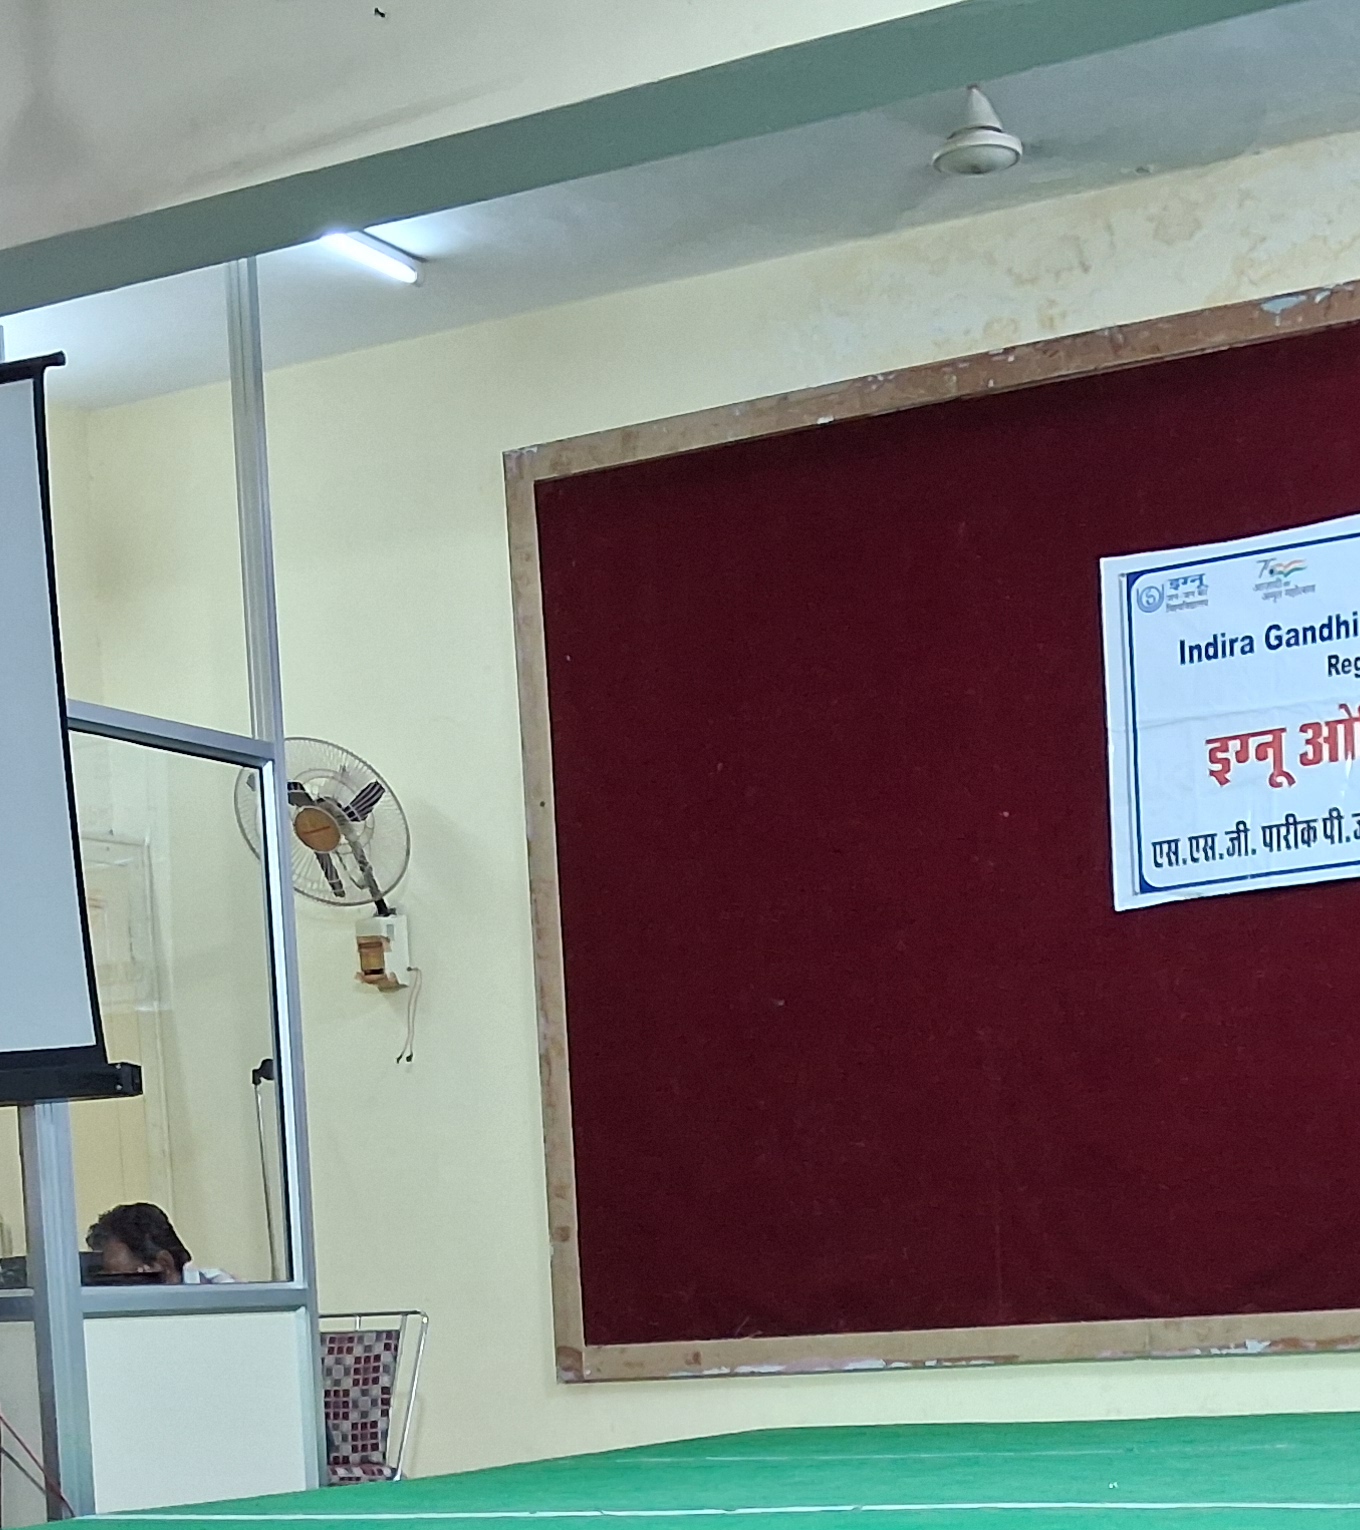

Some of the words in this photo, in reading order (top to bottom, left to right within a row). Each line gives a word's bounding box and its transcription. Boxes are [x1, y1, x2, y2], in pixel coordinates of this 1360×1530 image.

[1179, 631, 1255, 667] Indira
[1265, 615, 1360, 653] Gandhi
[1206, 725, 1296, 789] इग्नू
[1151, 820, 1257, 869] एस.एस.जी.
[1261, 813, 1319, 854] पारीक
